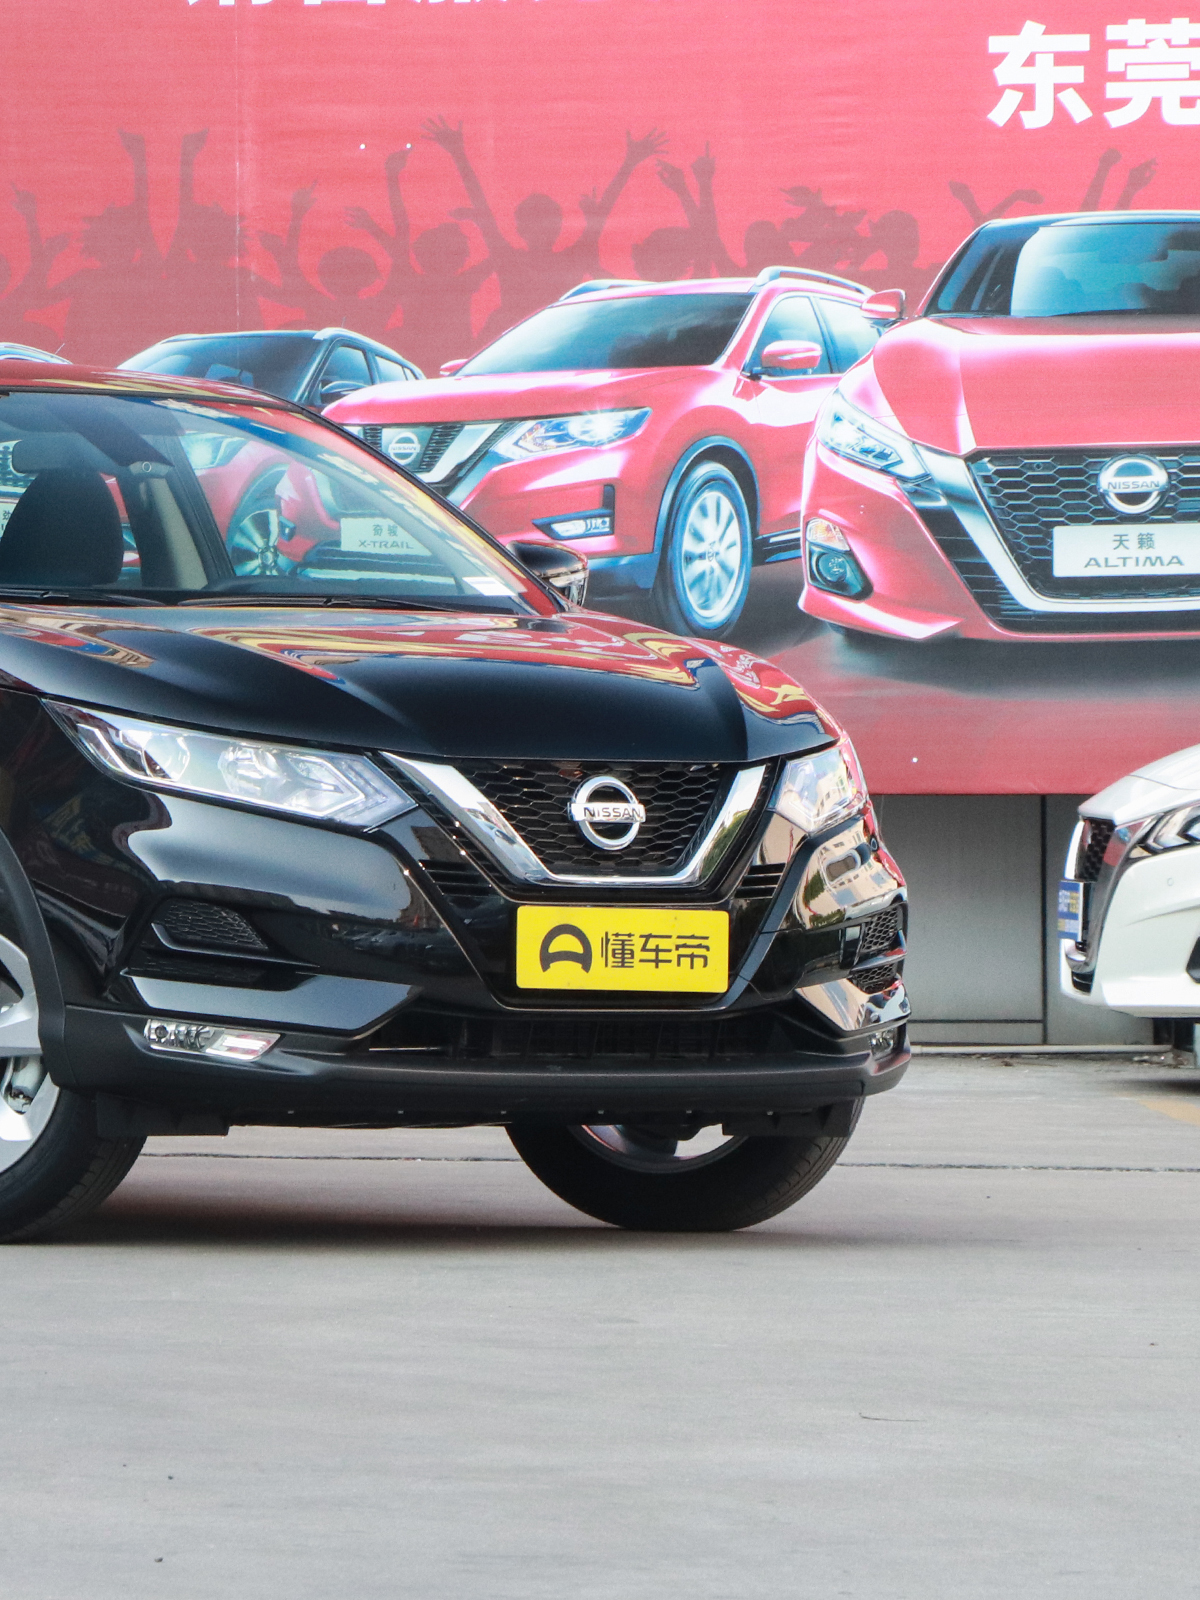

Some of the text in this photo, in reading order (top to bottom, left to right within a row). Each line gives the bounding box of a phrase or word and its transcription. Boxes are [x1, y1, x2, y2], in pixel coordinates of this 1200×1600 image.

[986, 18, 1200, 129] 东莞
[1107, 480, 1161, 490] NISSAN
[358, 539, 414, 550] X-TRAIL
[1112, 532, 1156, 550] 天籁
[1084, 555, 1185, 569] ALTIMA
[583, 806, 644, 820] NISSAN
[600, 931, 711, 970] 懂车帝
